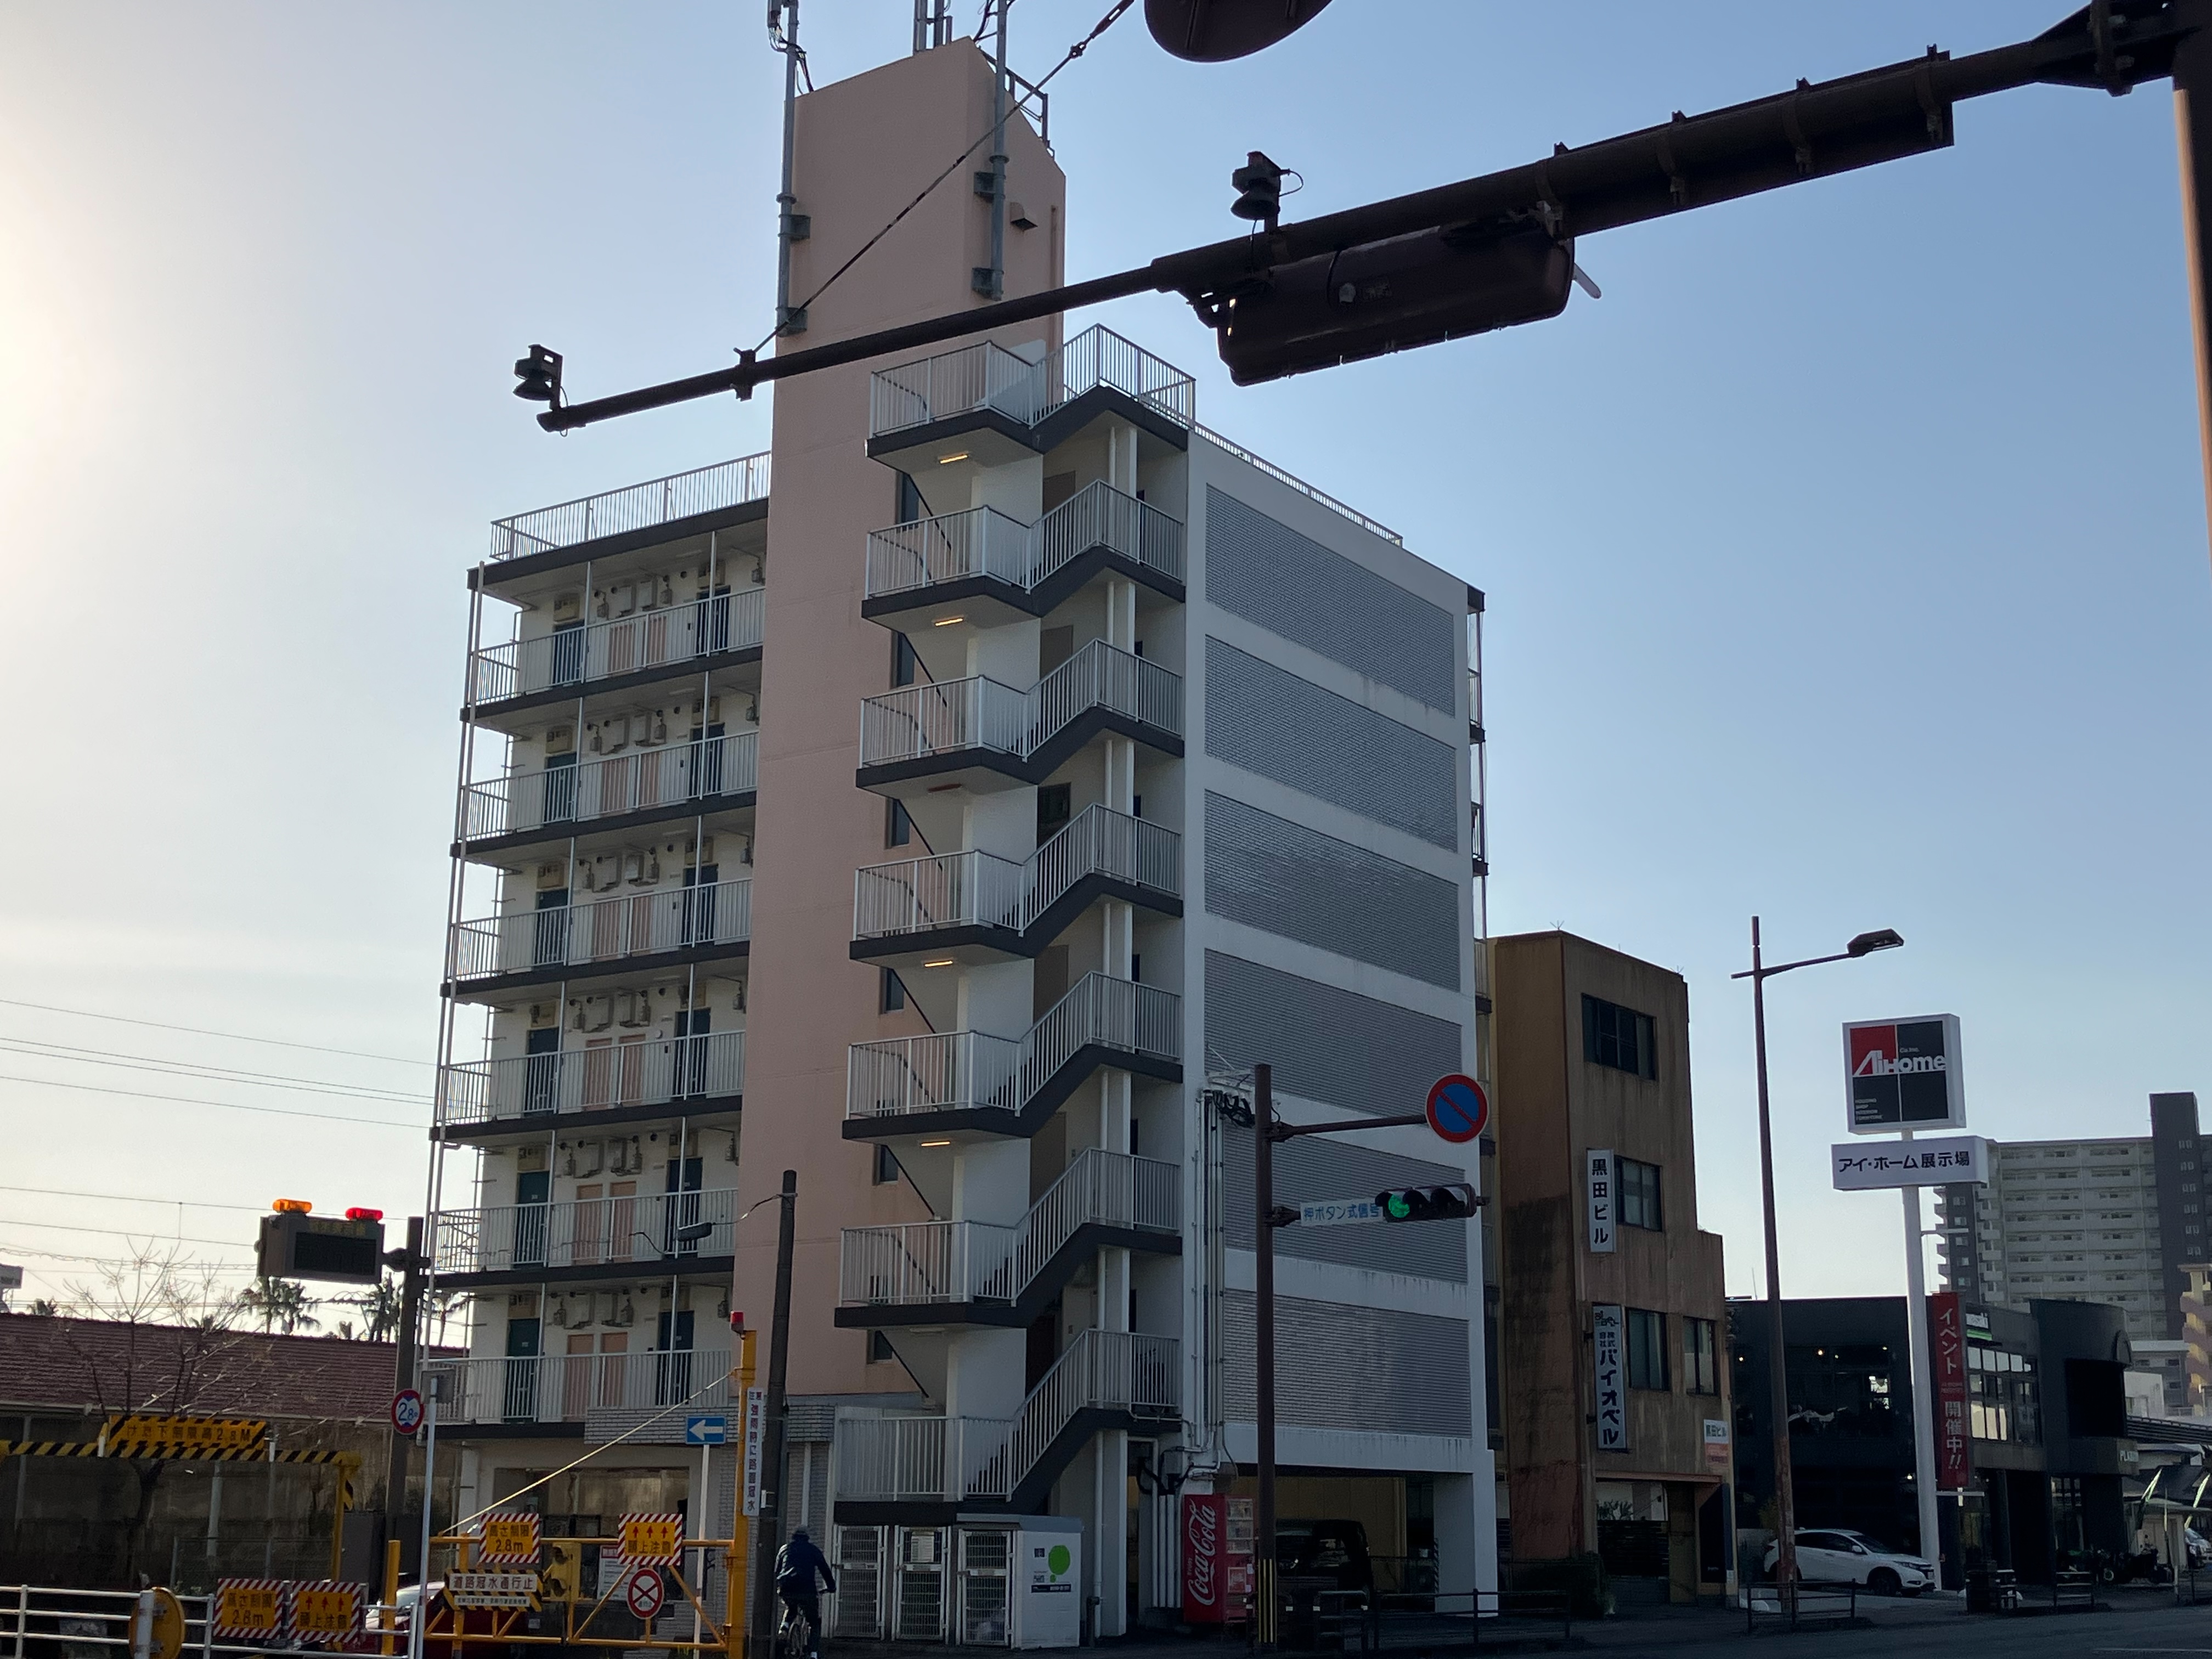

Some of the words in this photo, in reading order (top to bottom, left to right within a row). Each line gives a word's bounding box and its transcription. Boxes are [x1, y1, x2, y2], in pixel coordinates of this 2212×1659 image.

[1838, 1150, 1970, 1172] アイ・ホーム展示場
[1304, 1203, 1380, 1222] 押ボタン式信号
[1592, 1159, 1609, 1244] 黒田ビル
[1940, 1308, 1958, 1375] イベント
[1600, 1349, 1621, 1445] バイオベル
